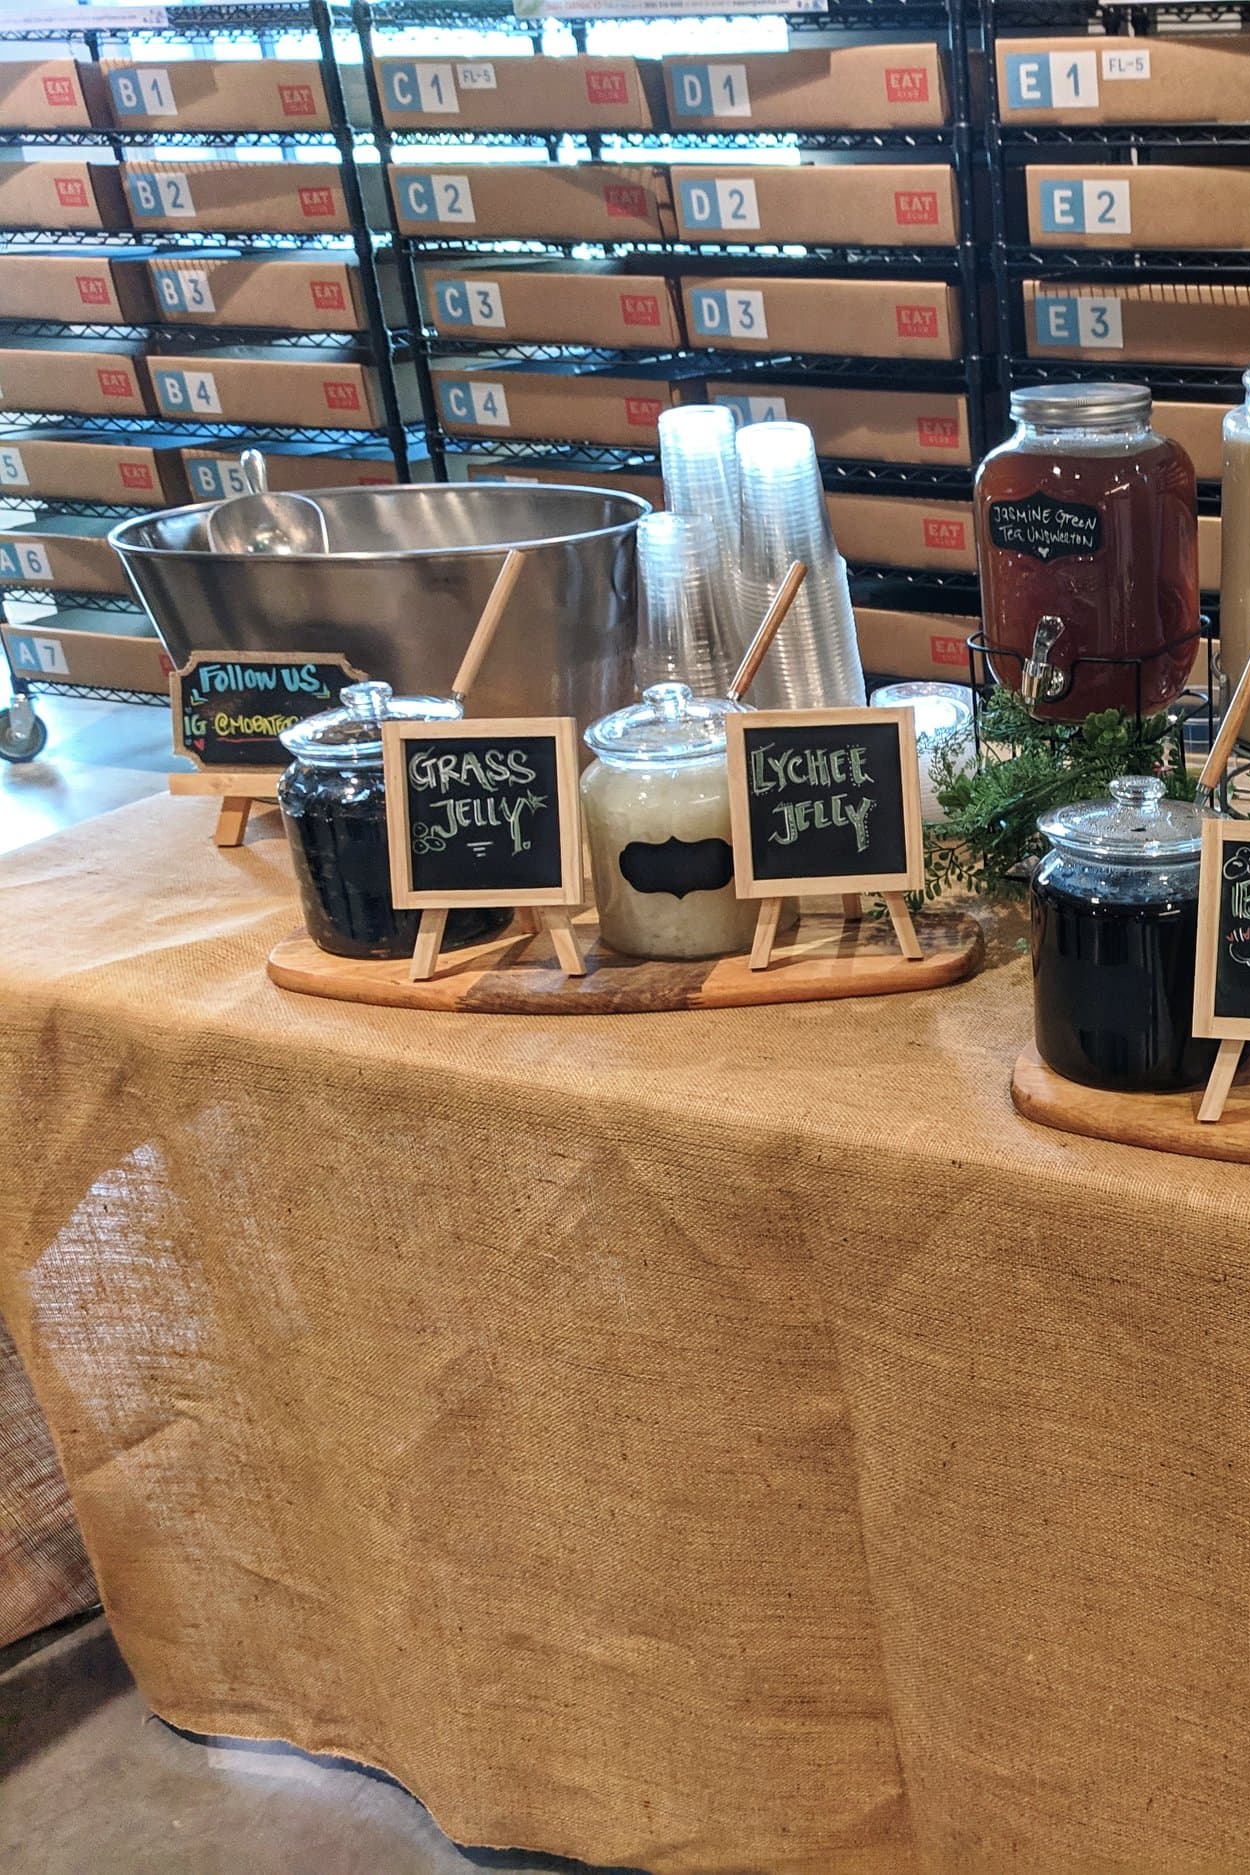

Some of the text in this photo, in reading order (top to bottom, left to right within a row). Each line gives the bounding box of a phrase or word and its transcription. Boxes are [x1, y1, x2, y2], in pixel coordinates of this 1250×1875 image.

[462, 68, 492, 84] FL-5
[1108, 58, 1144, 73] FL-5
[26, 549, 42, 574] 6
[409, 747, 537, 794] GRASS
[751, 743, 875, 795] LYCHEE
[429, 797, 527, 856] JELLY
[768, 793, 876, 853] JELLY
